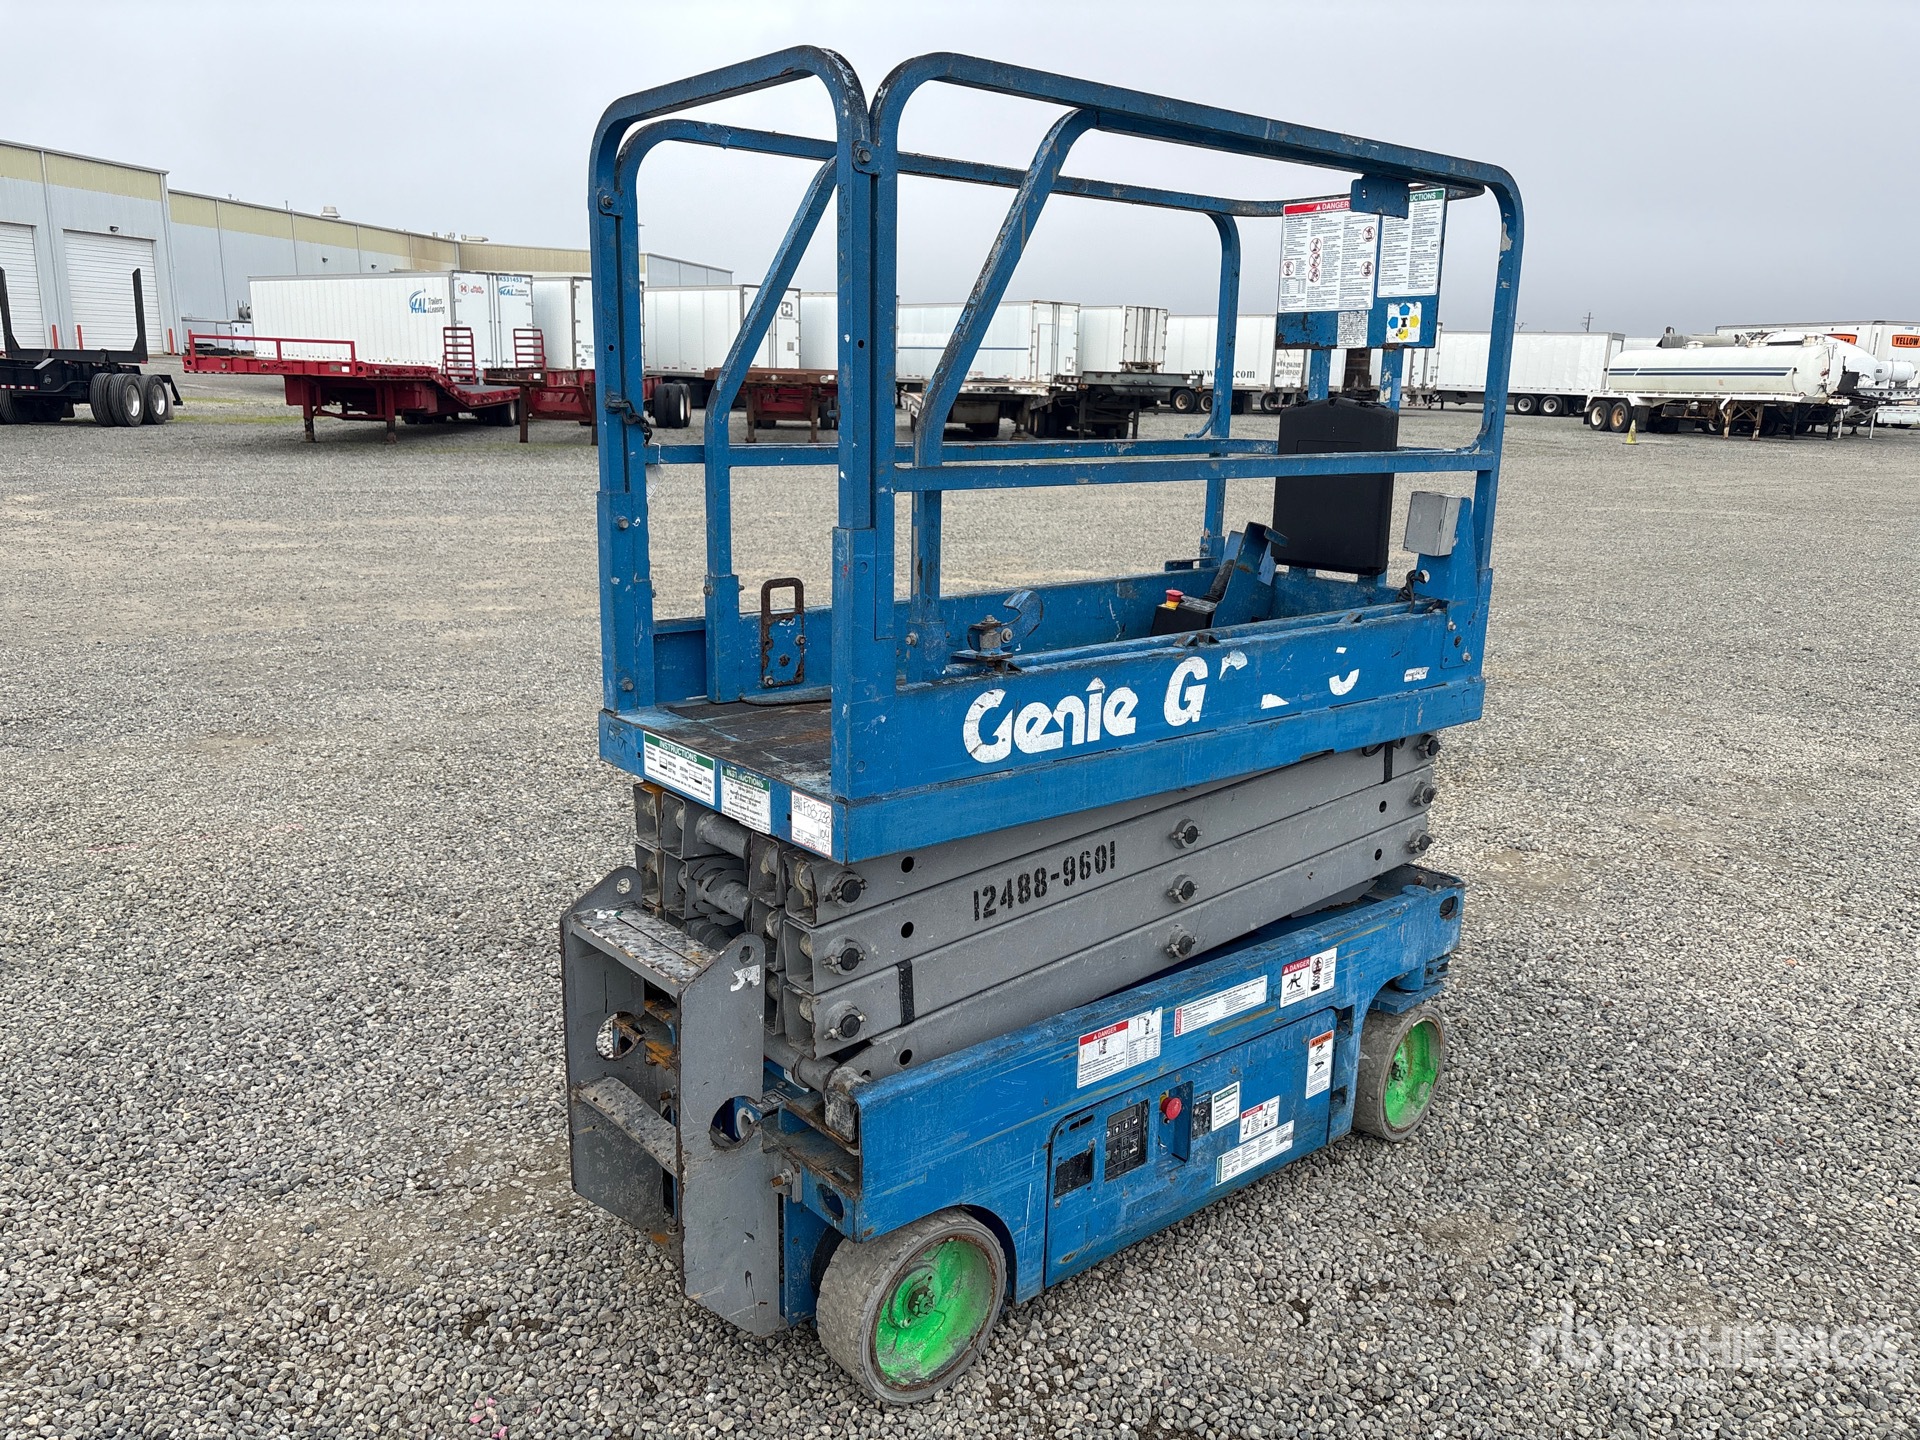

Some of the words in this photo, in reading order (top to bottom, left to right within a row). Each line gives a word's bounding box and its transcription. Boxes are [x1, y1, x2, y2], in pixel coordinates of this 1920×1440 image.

[1409, 192, 1436, 201] UCTIONS
[1321, 201, 1350, 210] DANGER
[1895, 337, 1920, 346] YELLOW
[963, 677, 1139, 764] Genie
[659, 739, 698, 763] INSTRUCTIONS
[973, 840, 1116, 922] 12488-9601
[1290, 959, 1310, 970] DANGER
[1097, 1026, 1117, 1039] DANGER
